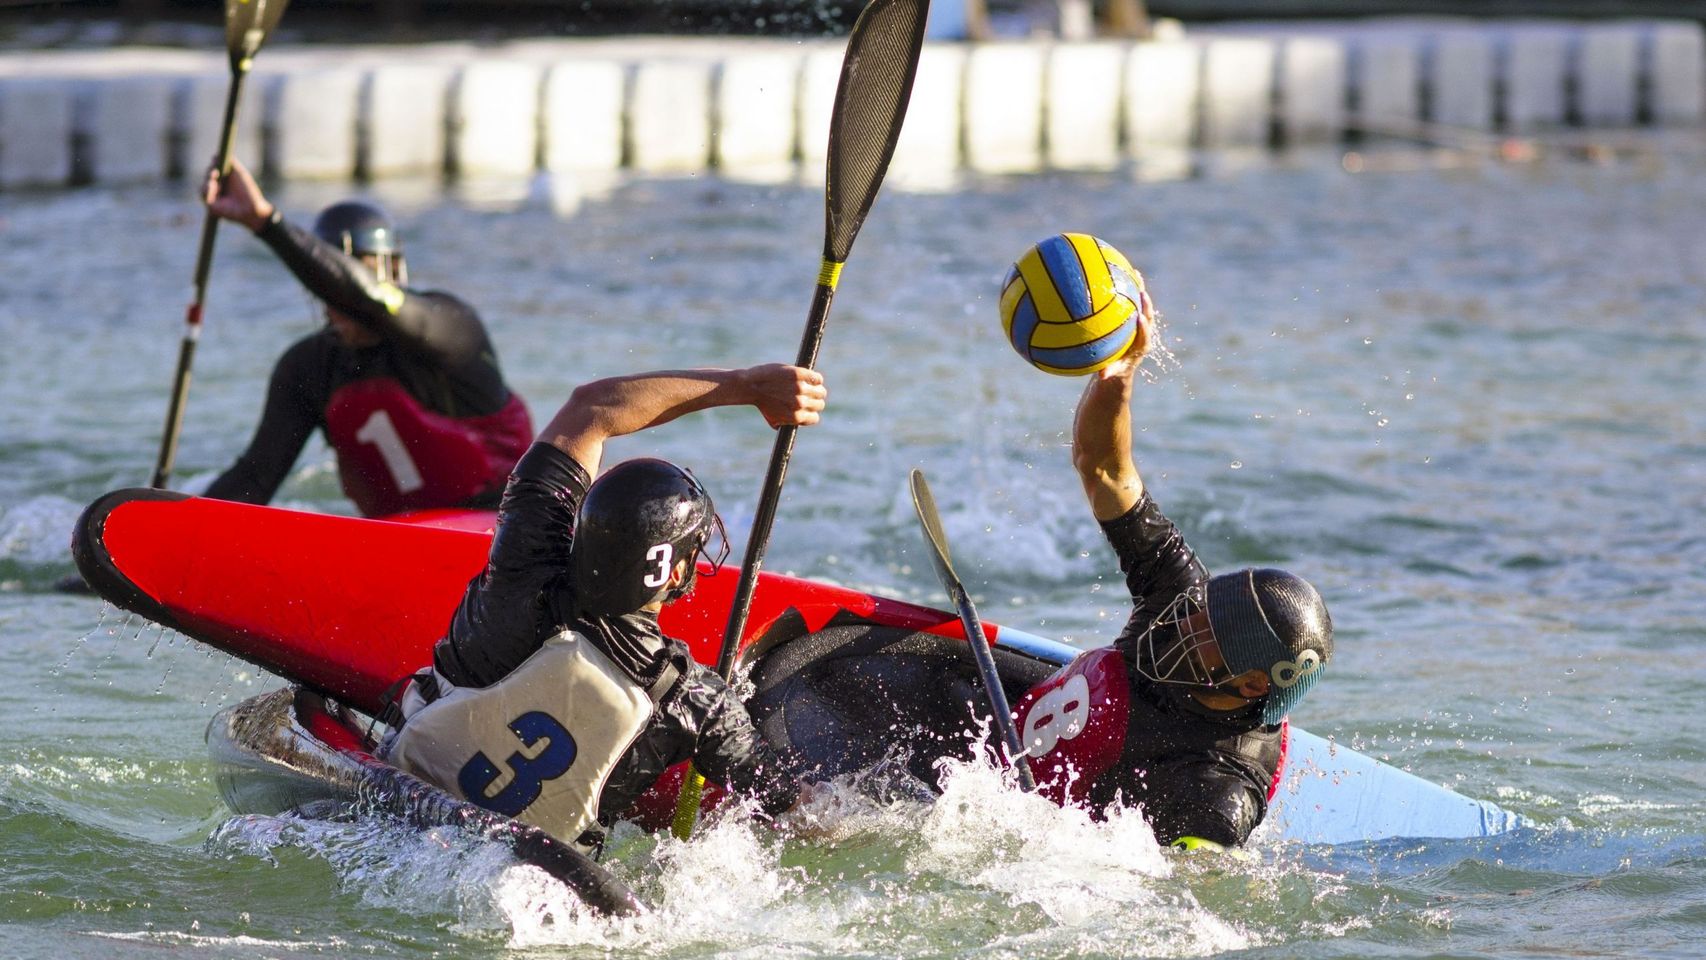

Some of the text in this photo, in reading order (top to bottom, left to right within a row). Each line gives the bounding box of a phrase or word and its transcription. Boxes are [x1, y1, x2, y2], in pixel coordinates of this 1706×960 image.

[357, 410, 423, 493] 1
[643, 543, 673, 588] 3
[1271, 649, 1319, 688] 8
[1022, 674, 1089, 758] 8
[458, 711, 577, 817] 3
